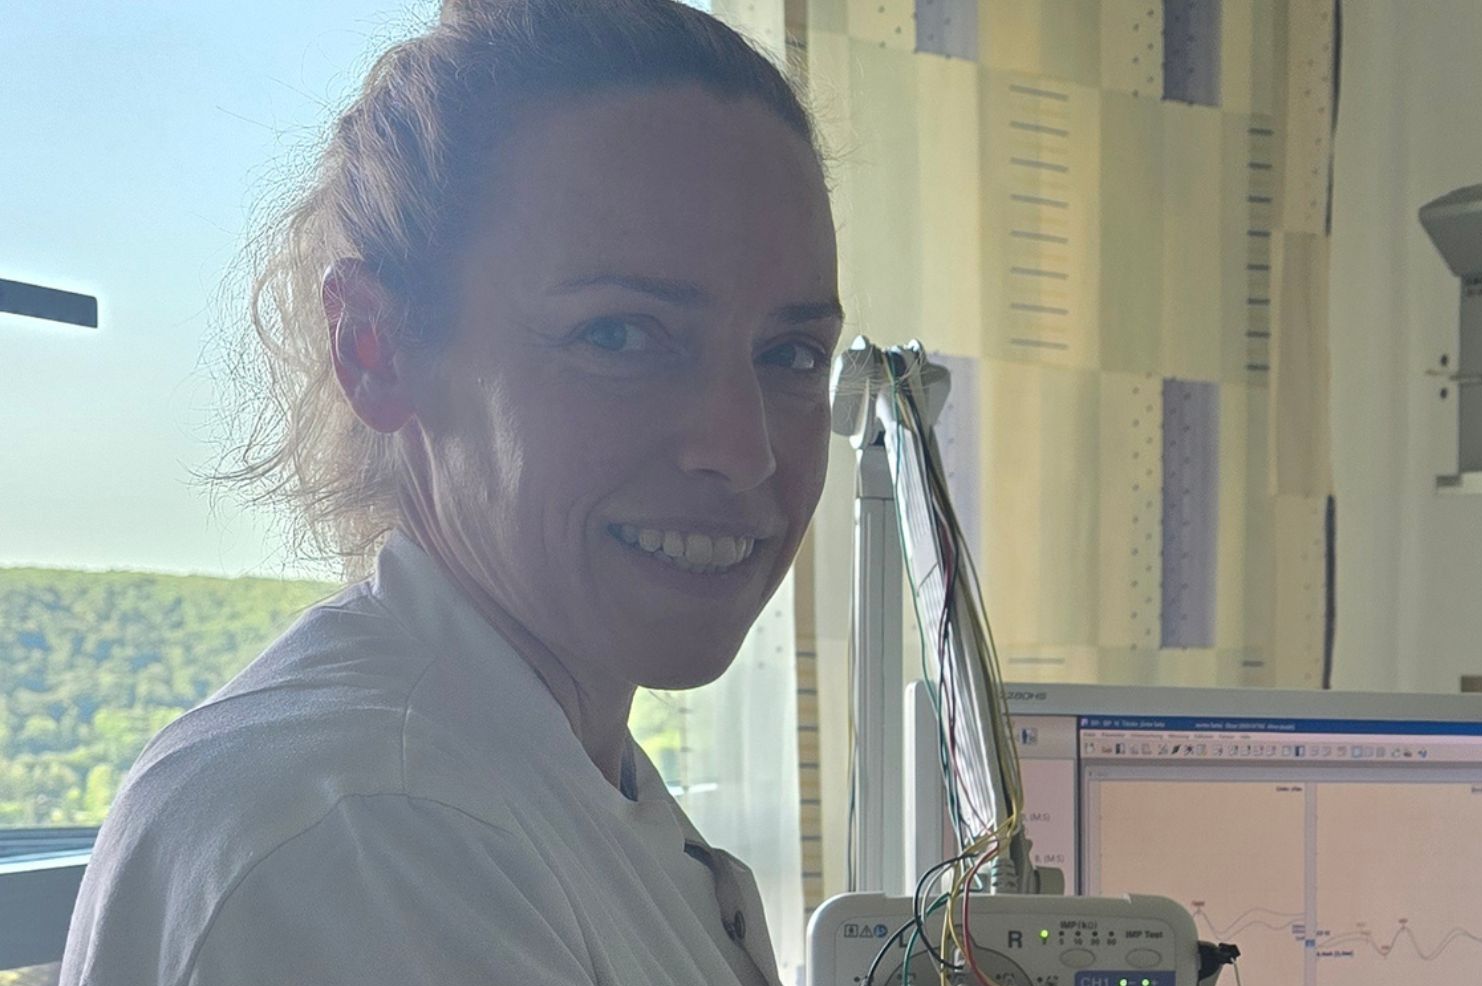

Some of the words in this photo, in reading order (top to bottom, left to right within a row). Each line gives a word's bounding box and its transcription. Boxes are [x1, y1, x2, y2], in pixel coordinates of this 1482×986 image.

[1007, 930, 1023, 948] R
[1125, 930, 1143, 939] IMP
[1145, 930, 1164, 939] Test
